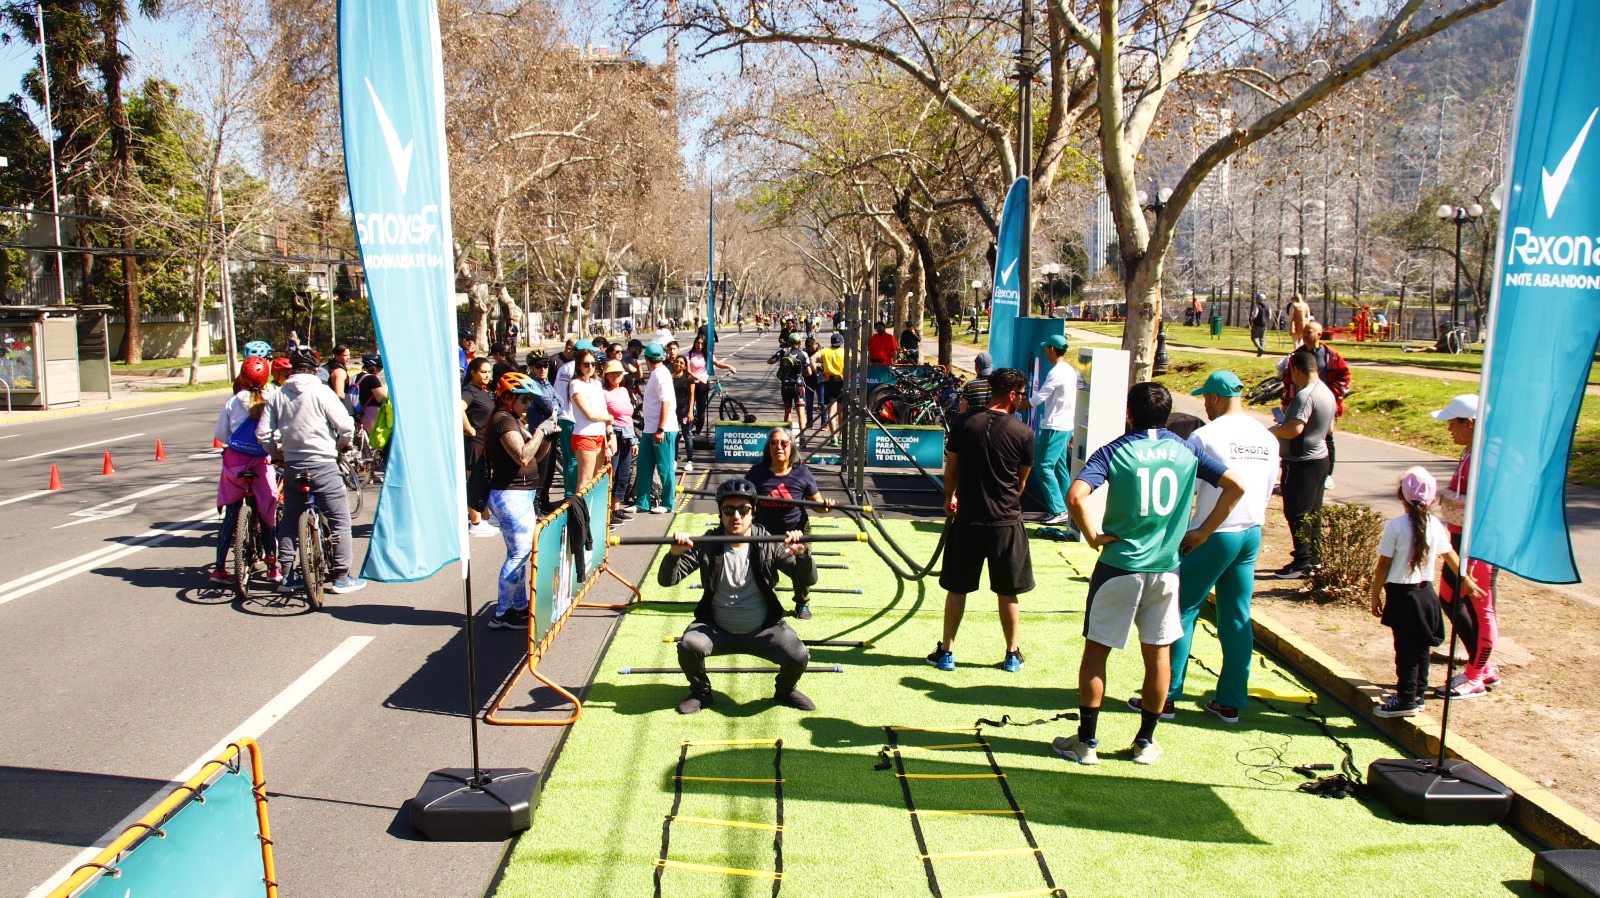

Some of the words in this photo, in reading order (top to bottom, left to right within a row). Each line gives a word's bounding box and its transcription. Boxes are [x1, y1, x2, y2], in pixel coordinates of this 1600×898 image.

[1135, 448, 1177, 463] KANE
[1229, 442, 1269, 456] Rexona
[1136, 467, 1178, 517] 10
